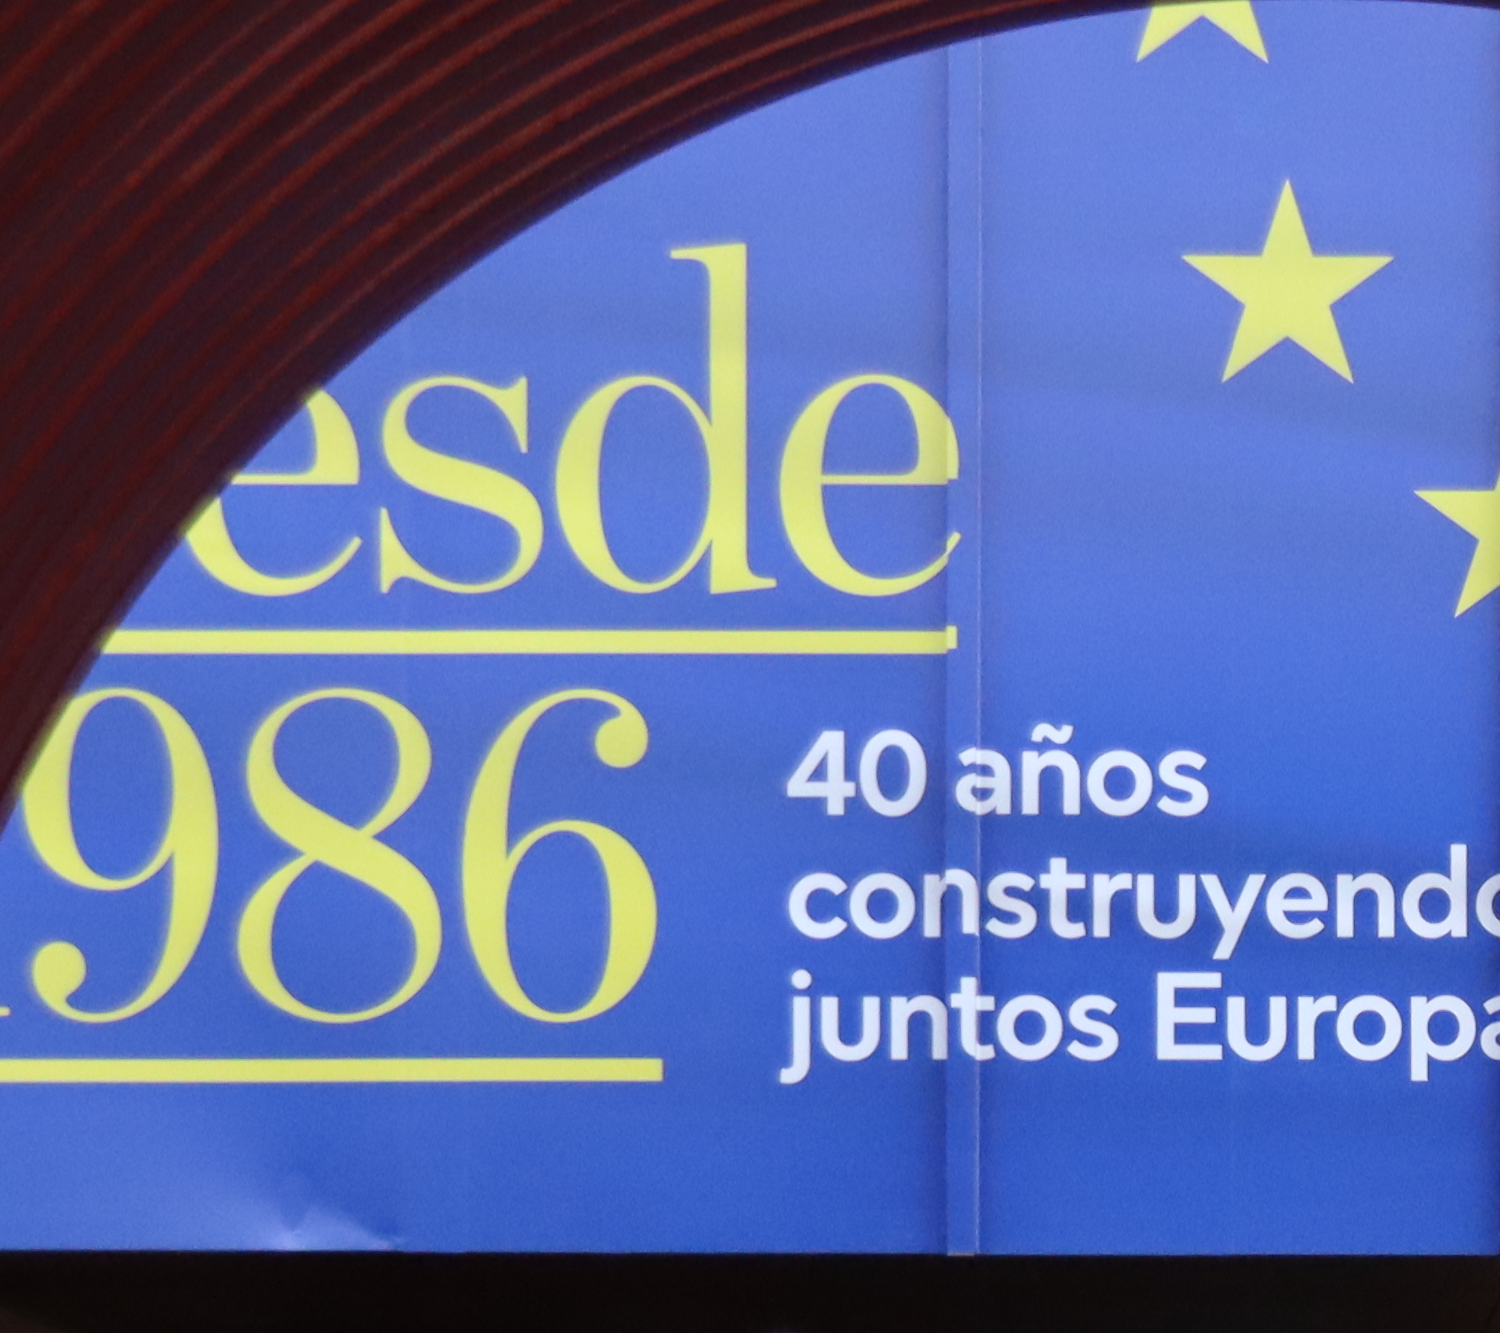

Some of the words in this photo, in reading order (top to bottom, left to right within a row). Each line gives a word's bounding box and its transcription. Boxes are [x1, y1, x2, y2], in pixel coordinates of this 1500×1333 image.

[786, 728, 927, 817] 40
[955, 722, 1210, 817] años
[779, 969, 1119, 1084] juntos
